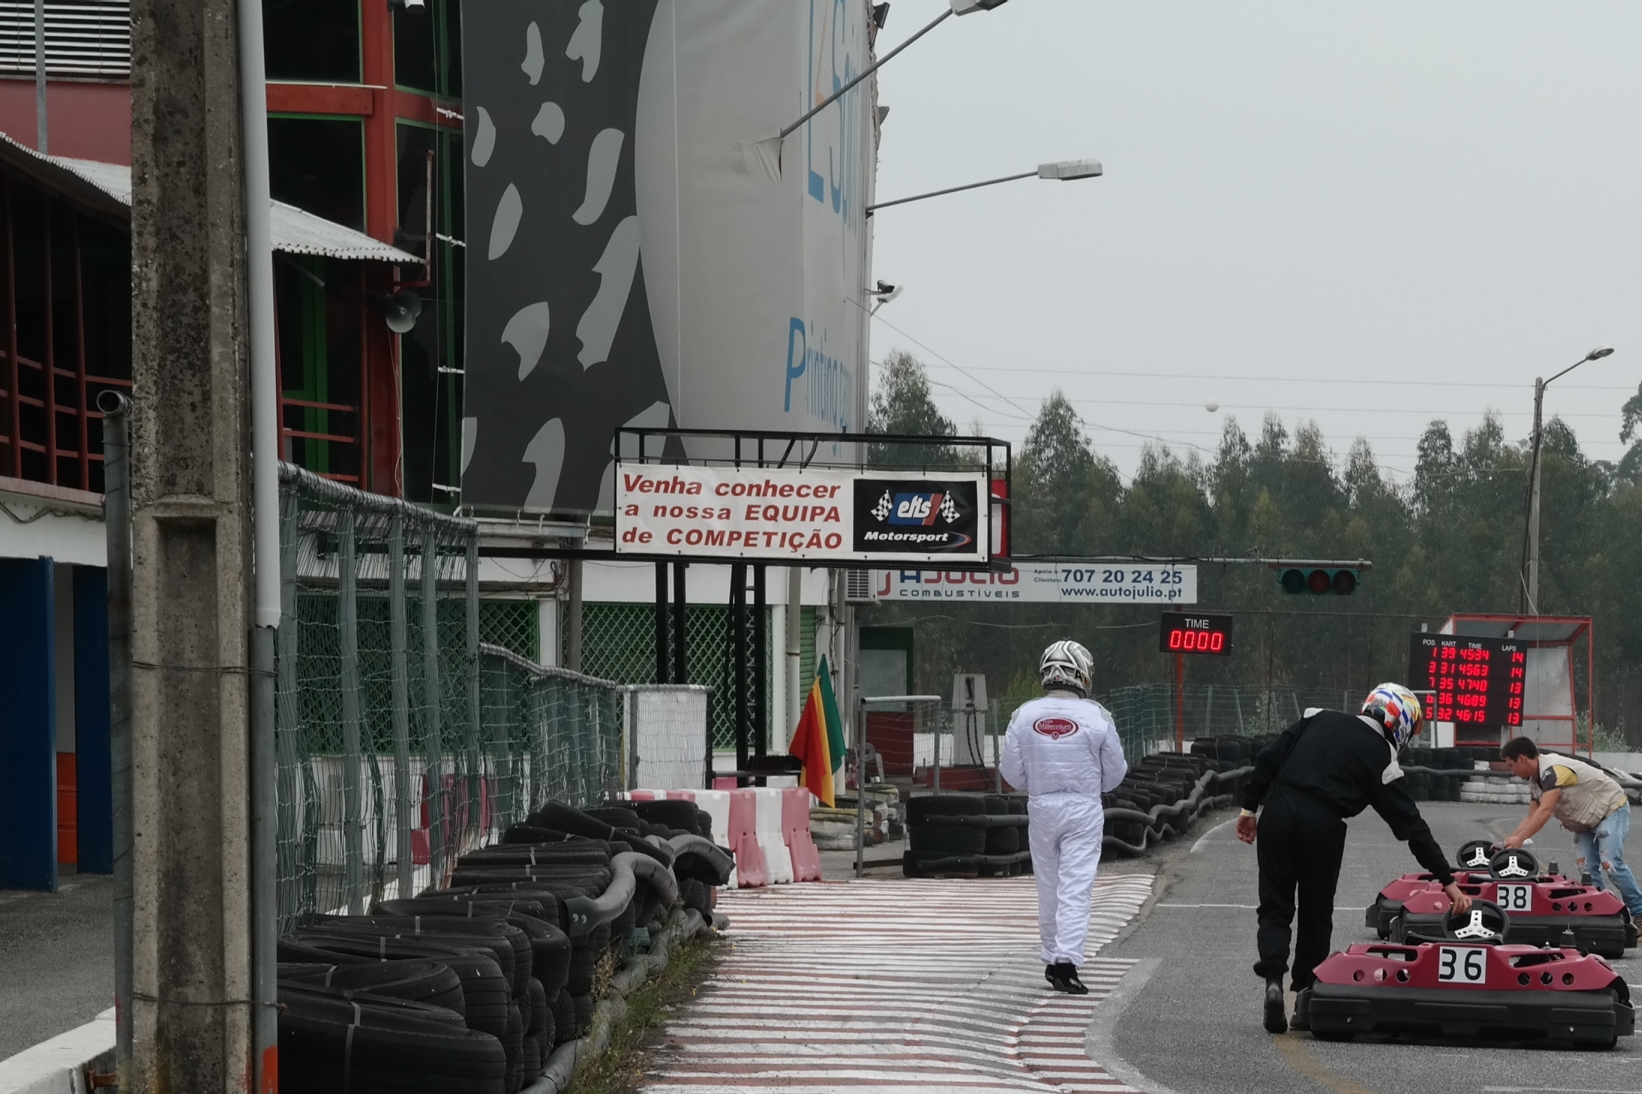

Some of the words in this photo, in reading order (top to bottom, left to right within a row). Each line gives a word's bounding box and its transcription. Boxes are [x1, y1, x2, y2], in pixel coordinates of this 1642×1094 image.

[623, 474, 702, 496] Venha
[715, 479, 841, 499] conhecer
[624, 503, 640, 517] a
[653, 504, 732, 521] nossa
[744, 503, 841, 523] EQUIPA
[622, 527, 653, 544] de
[666, 527, 842, 553] COMPETIÇÃO
[863, 531, 949, 543] Motorsport
[1061, 569, 1096, 583] 707
[1102, 569, 1125, 583] 20
[1131, 570, 1154, 584] 24
[1160, 570, 1183, 584] 25
[1061, 586, 1183, 600] www.autojulio.pt
[1184, 618, 1210, 629] TIME
[1441, 640, 1457, 648] KART
[1467, 642, 1483, 650] TIME
[1432, 646, 1438, 658] 1
[1440, 647, 1456, 659] 39
[1511, 651, 1524, 663] 14
[1428, 661, 1437, 674] 3
[1440, 662, 1456, 674] 31
[1510, 667, 1523, 678] 14
[1428, 676, 1436, 688] 7
[1439, 677, 1454, 690] 35
[1509, 682, 1522, 694] 13
[1438, 692, 1453, 705] 36
[1508, 697, 1521, 709] 13
[1425, 707, 1433, 719] 5
[1437, 707, 1452, 720] 32
[1507, 712, 1520, 725] 13
[1498, 886, 1527, 909] 38
[1439, 948, 1483, 981] 36
